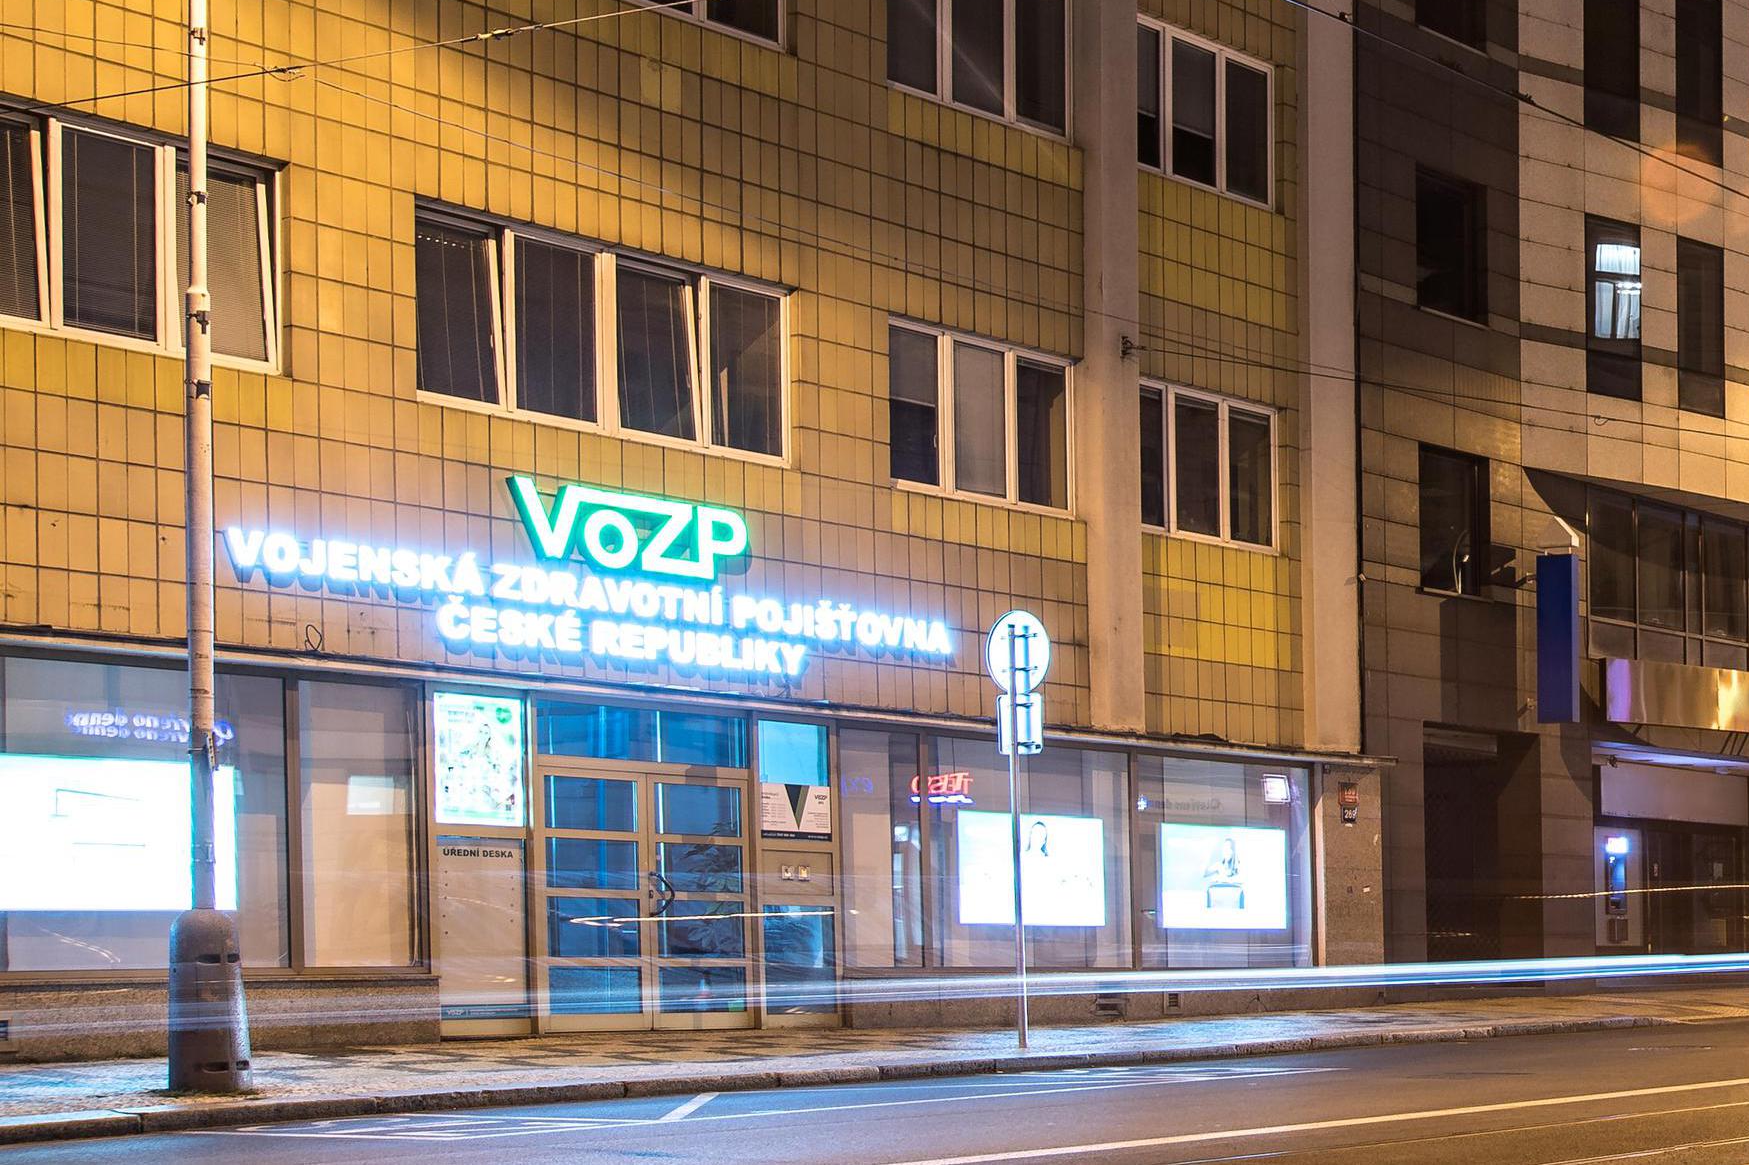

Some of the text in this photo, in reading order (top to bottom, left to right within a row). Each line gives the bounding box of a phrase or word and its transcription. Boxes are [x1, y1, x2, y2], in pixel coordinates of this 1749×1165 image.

[227, 526, 951, 655] VOJENSKÁ ZDRAVOTNÍ POJIŠŤOVNA
[438, 596, 807, 676] ČESKÉ REPUBLIKY
[482, 849, 514, 859] DESKA
